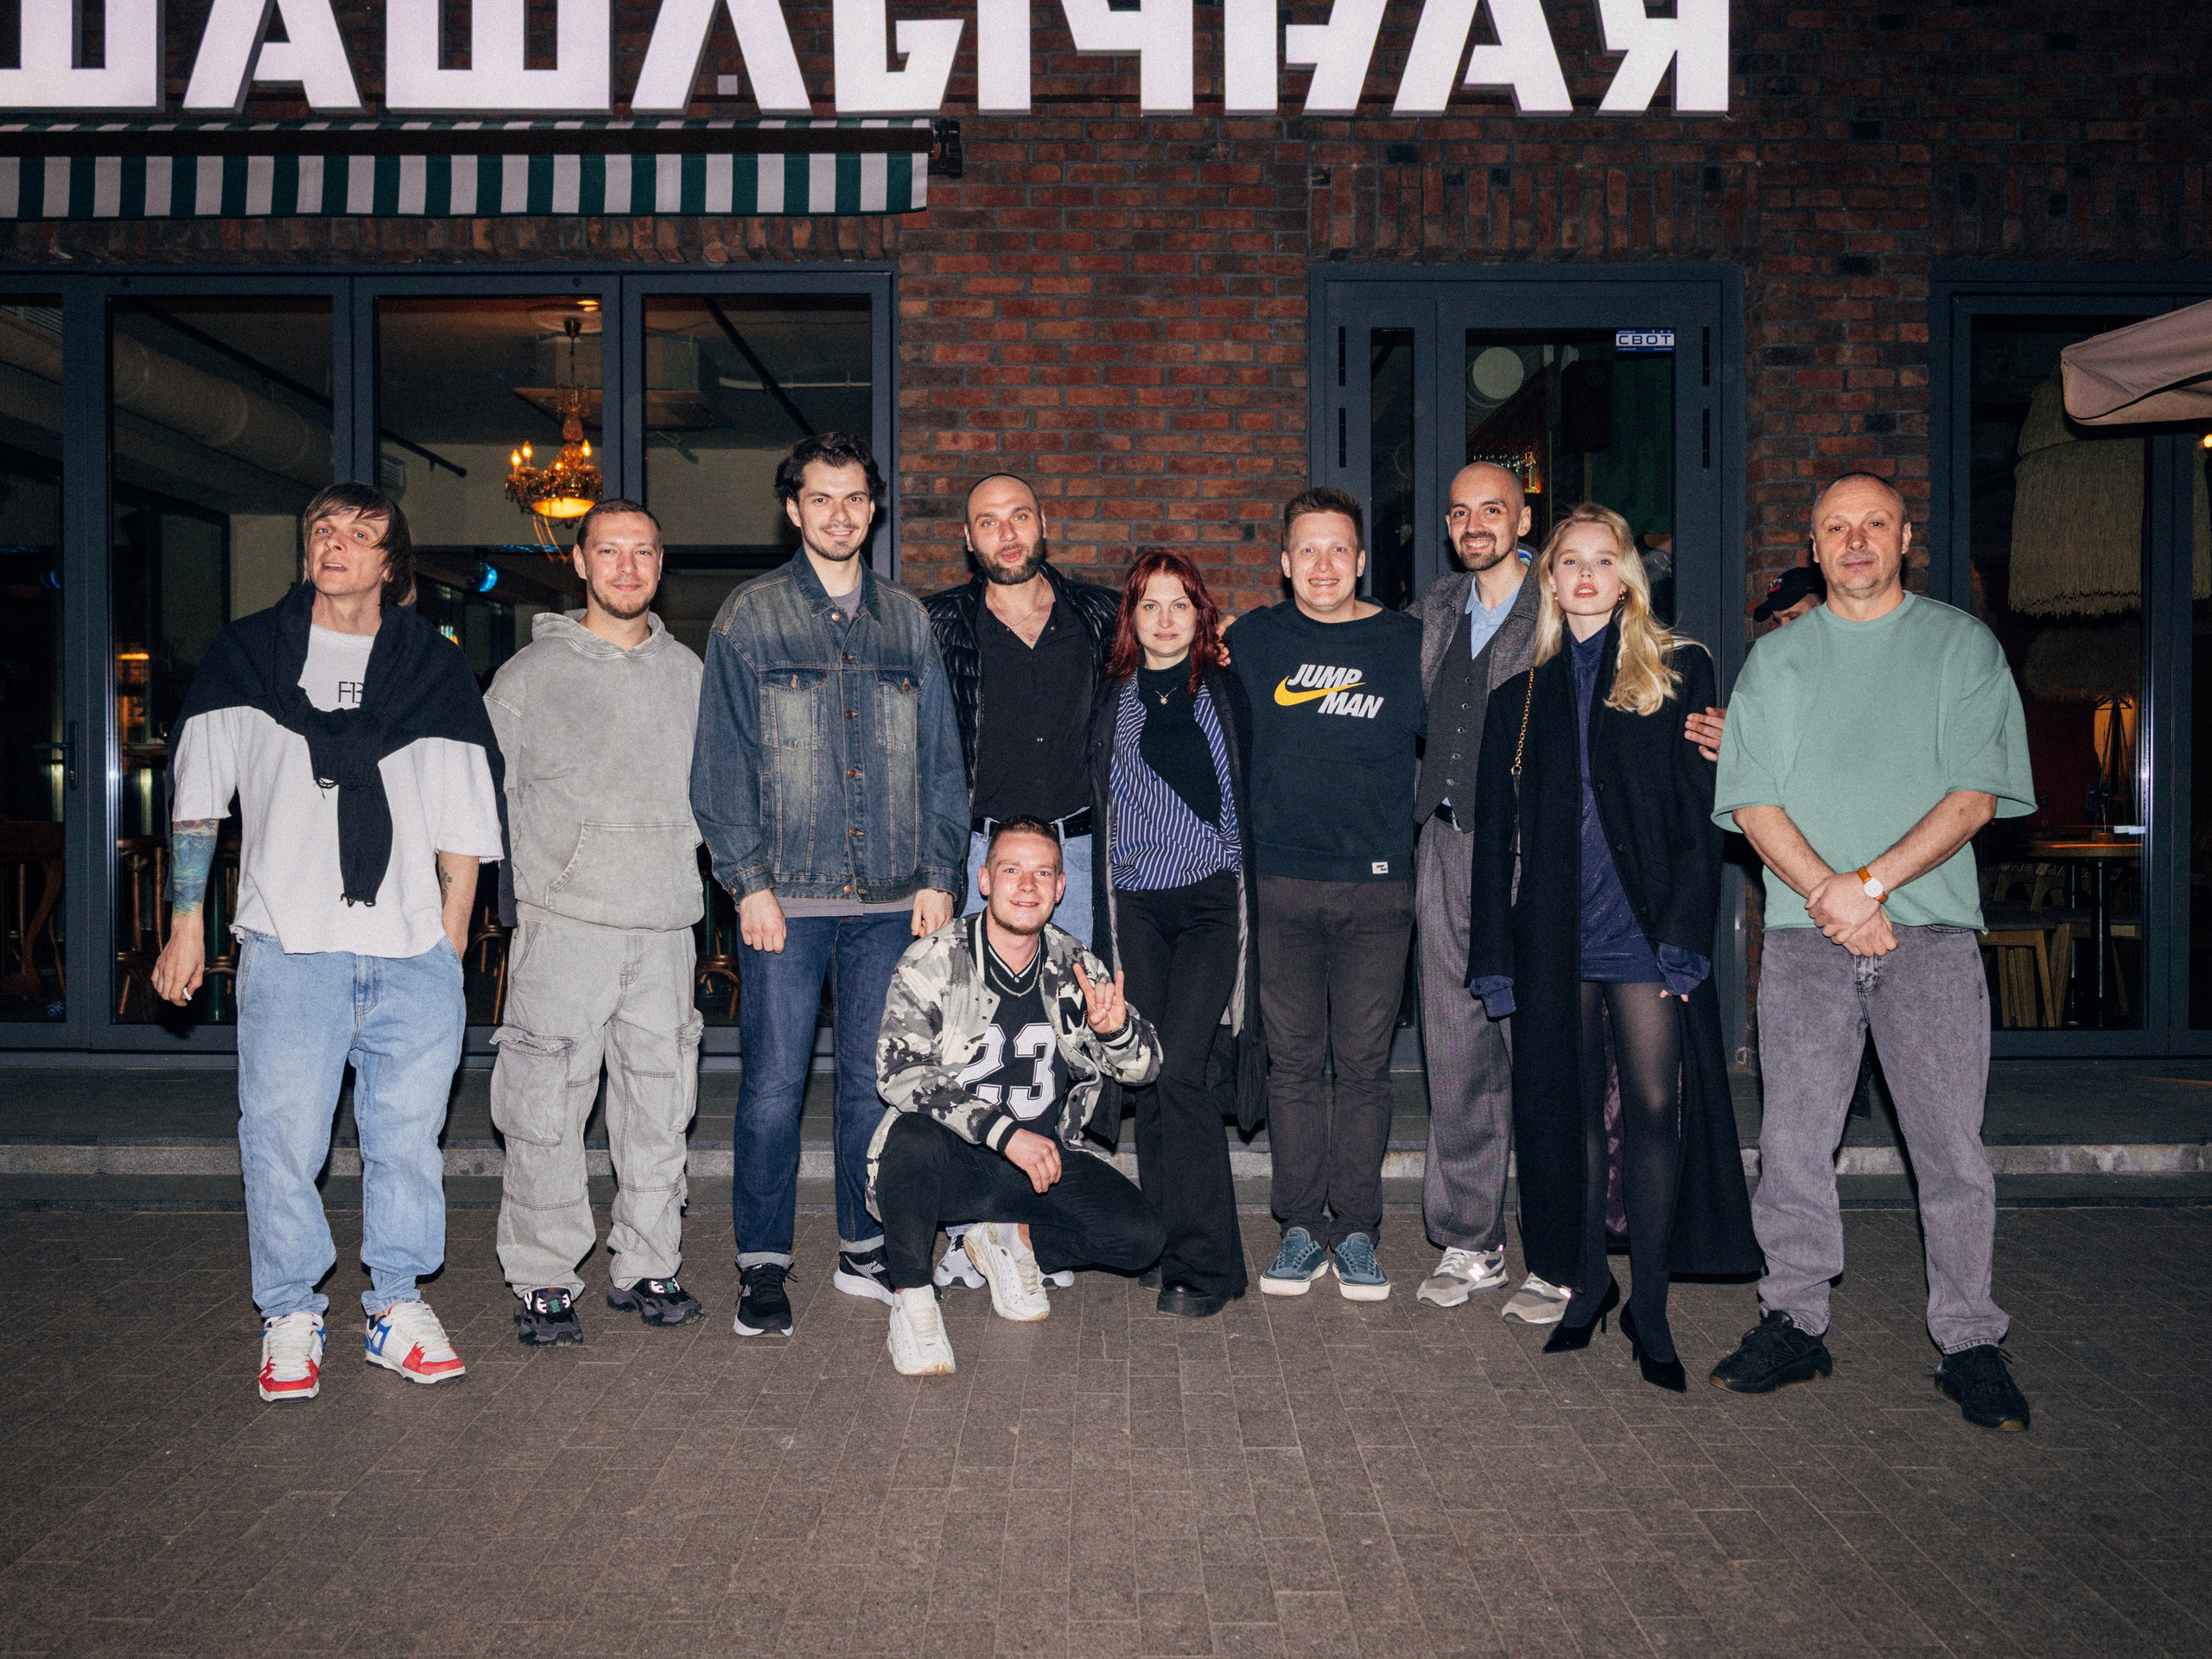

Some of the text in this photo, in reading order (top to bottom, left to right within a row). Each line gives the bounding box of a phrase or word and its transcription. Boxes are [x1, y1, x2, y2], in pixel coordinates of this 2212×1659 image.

[1287, 664, 1363, 689] JUMP
[1317, 691, 1384, 719] MAN
[953, 1022, 1056, 1121] 23
